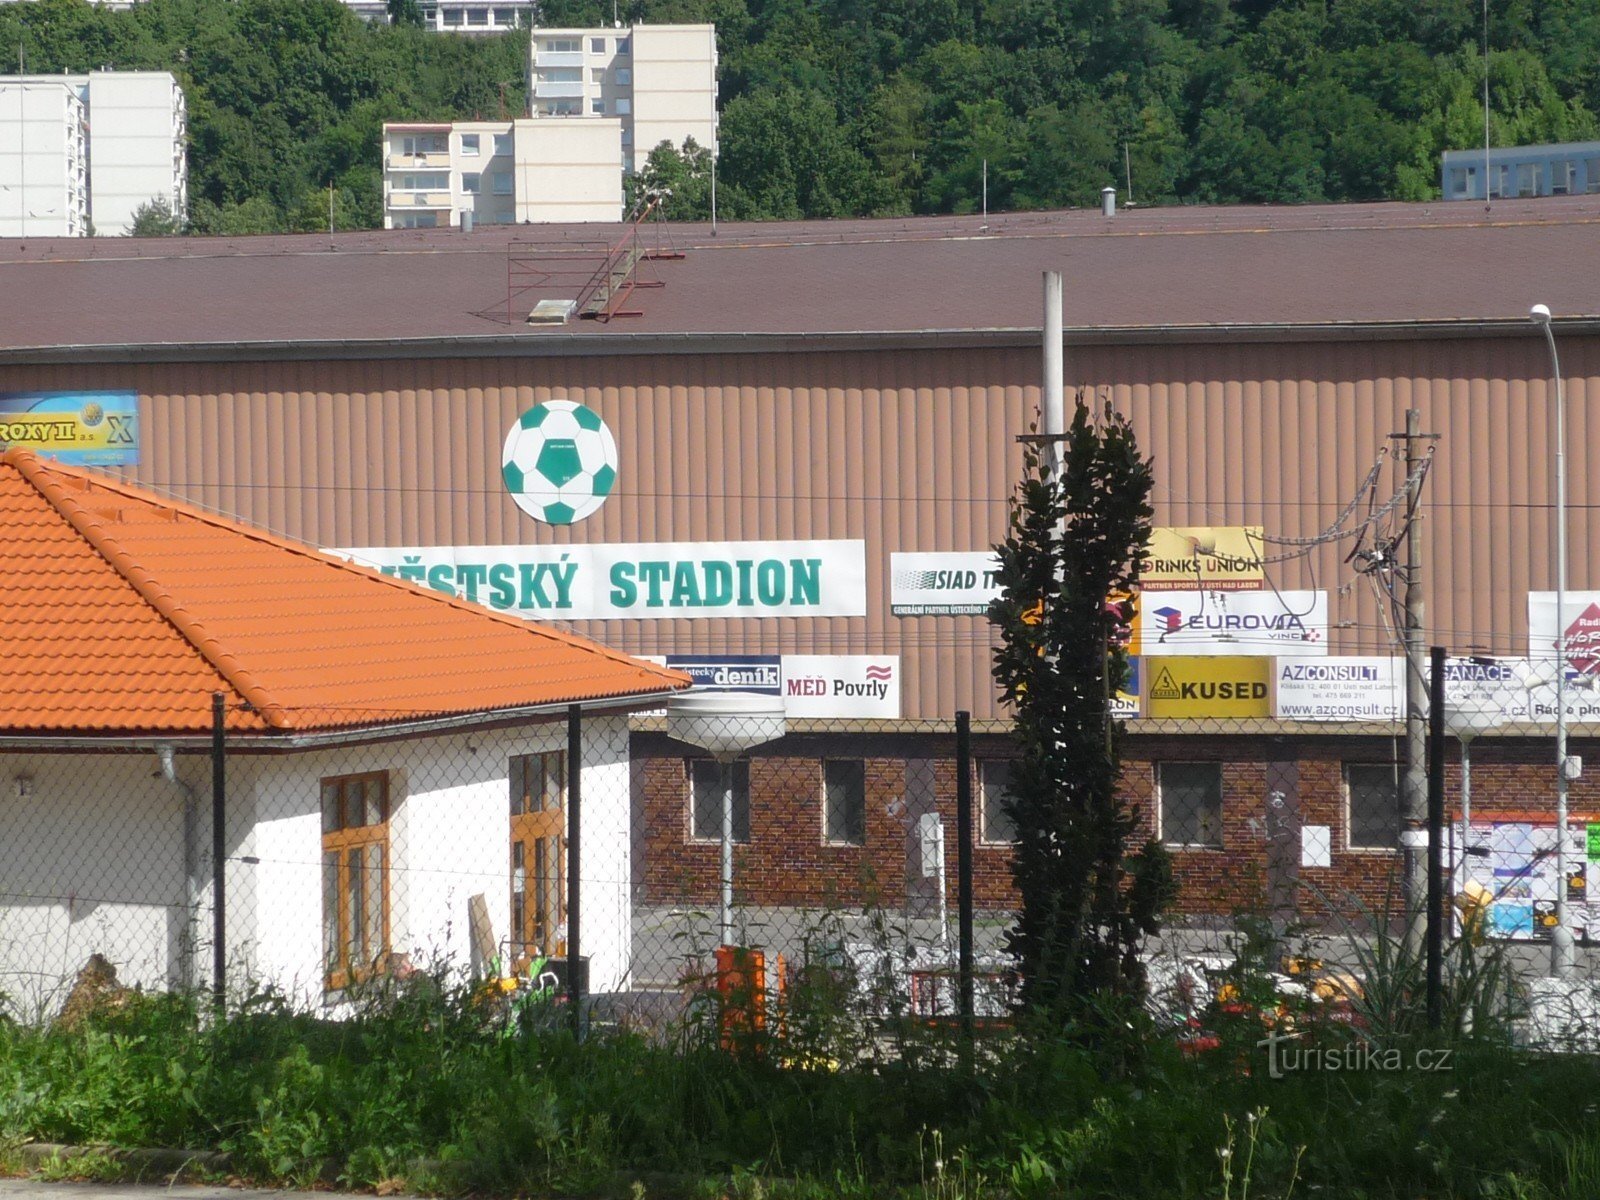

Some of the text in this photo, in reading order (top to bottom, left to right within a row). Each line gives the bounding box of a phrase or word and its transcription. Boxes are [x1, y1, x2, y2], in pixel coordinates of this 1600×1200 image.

[1206, 558, 1261, 573] UNION
[609, 557, 822, 609] STADION
[936, 570, 977, 590] SIAD
[1189, 614, 1304, 630] EUROVIA
[714, 666, 777, 686] deník
[833, 679, 888, 700] Povrly
[1181, 682, 1268, 699] KUSED
[1281, 703, 1398, 715] www.azconsult.cz
[1535, 704, 1575, 715] Rado
